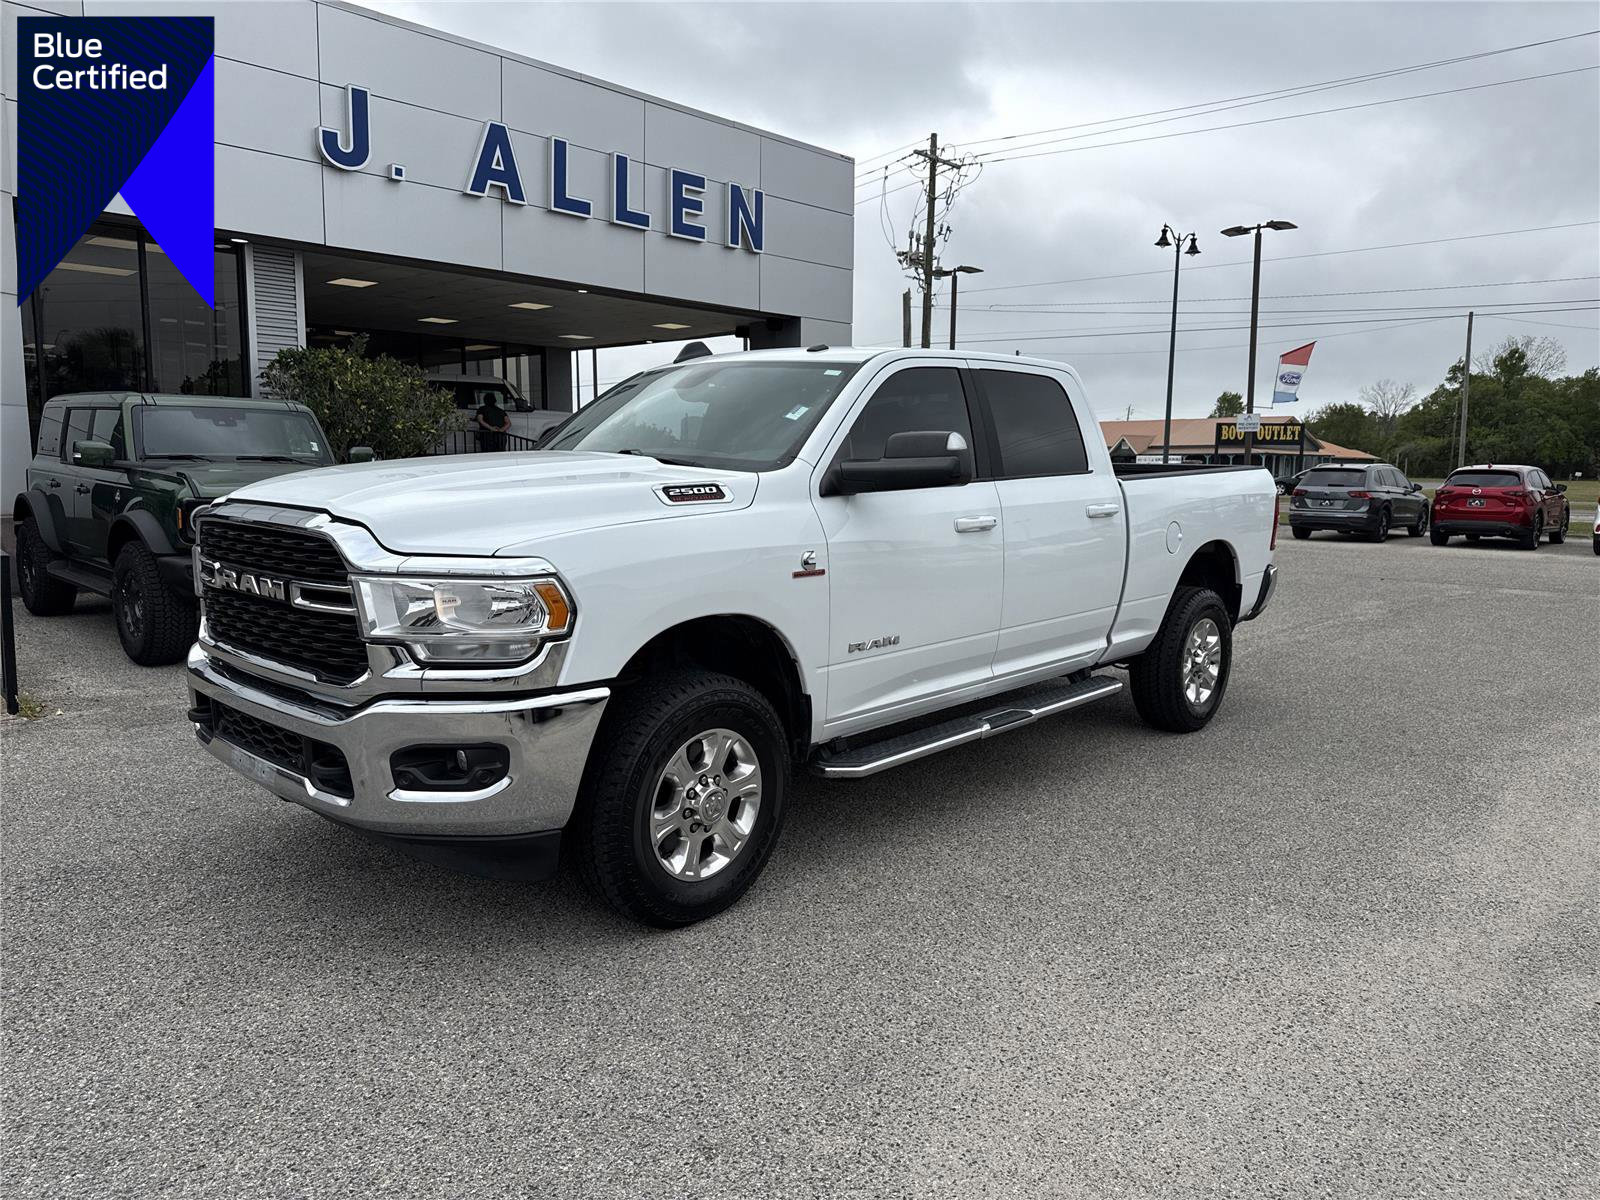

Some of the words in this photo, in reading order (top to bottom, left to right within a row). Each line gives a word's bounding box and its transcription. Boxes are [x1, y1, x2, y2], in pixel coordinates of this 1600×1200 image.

[315, 83, 406, 181] J.
[462, 119, 765, 254] ALLEN
[1281, 372, 1302, 385] Ford
[1257, 425, 1301, 440] OUTLET
[669, 486, 717, 496] 2500
[218, 567, 285, 600] RAM
[847, 635, 900, 654] RAM
